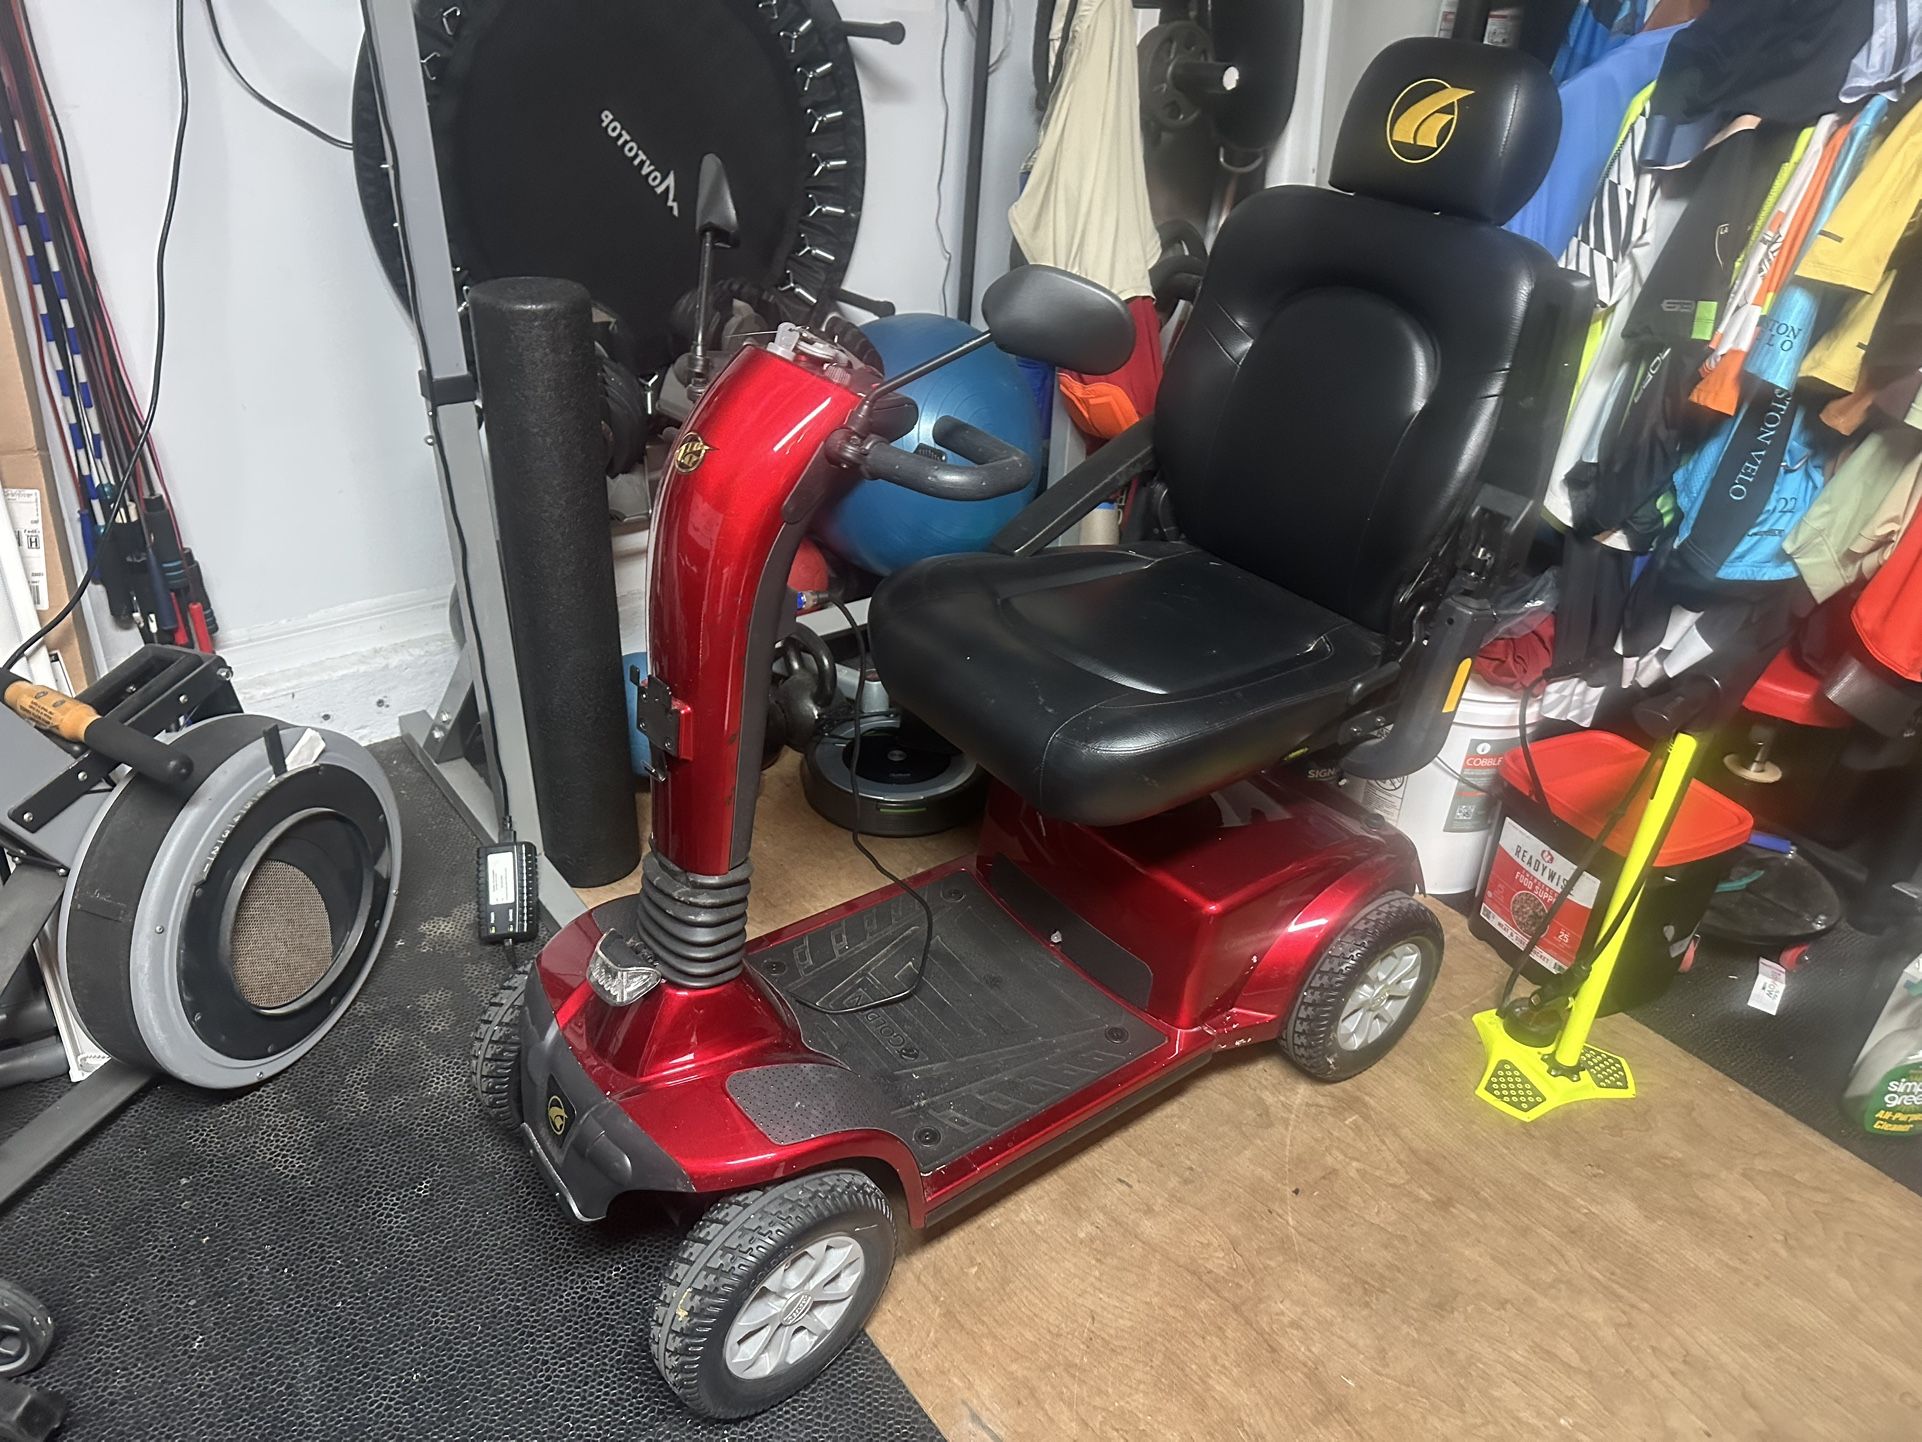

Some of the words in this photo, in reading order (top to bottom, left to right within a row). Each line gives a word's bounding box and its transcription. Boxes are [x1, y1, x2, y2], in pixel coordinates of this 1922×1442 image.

[1729, 449, 1768, 501] VELO
[1514, 844, 1574, 896] READYWIS
[1515, 871, 1534, 891] FOOD
[1534, 886, 1557, 904] SUPP
[849, 993, 905, 1047] GOLDN
